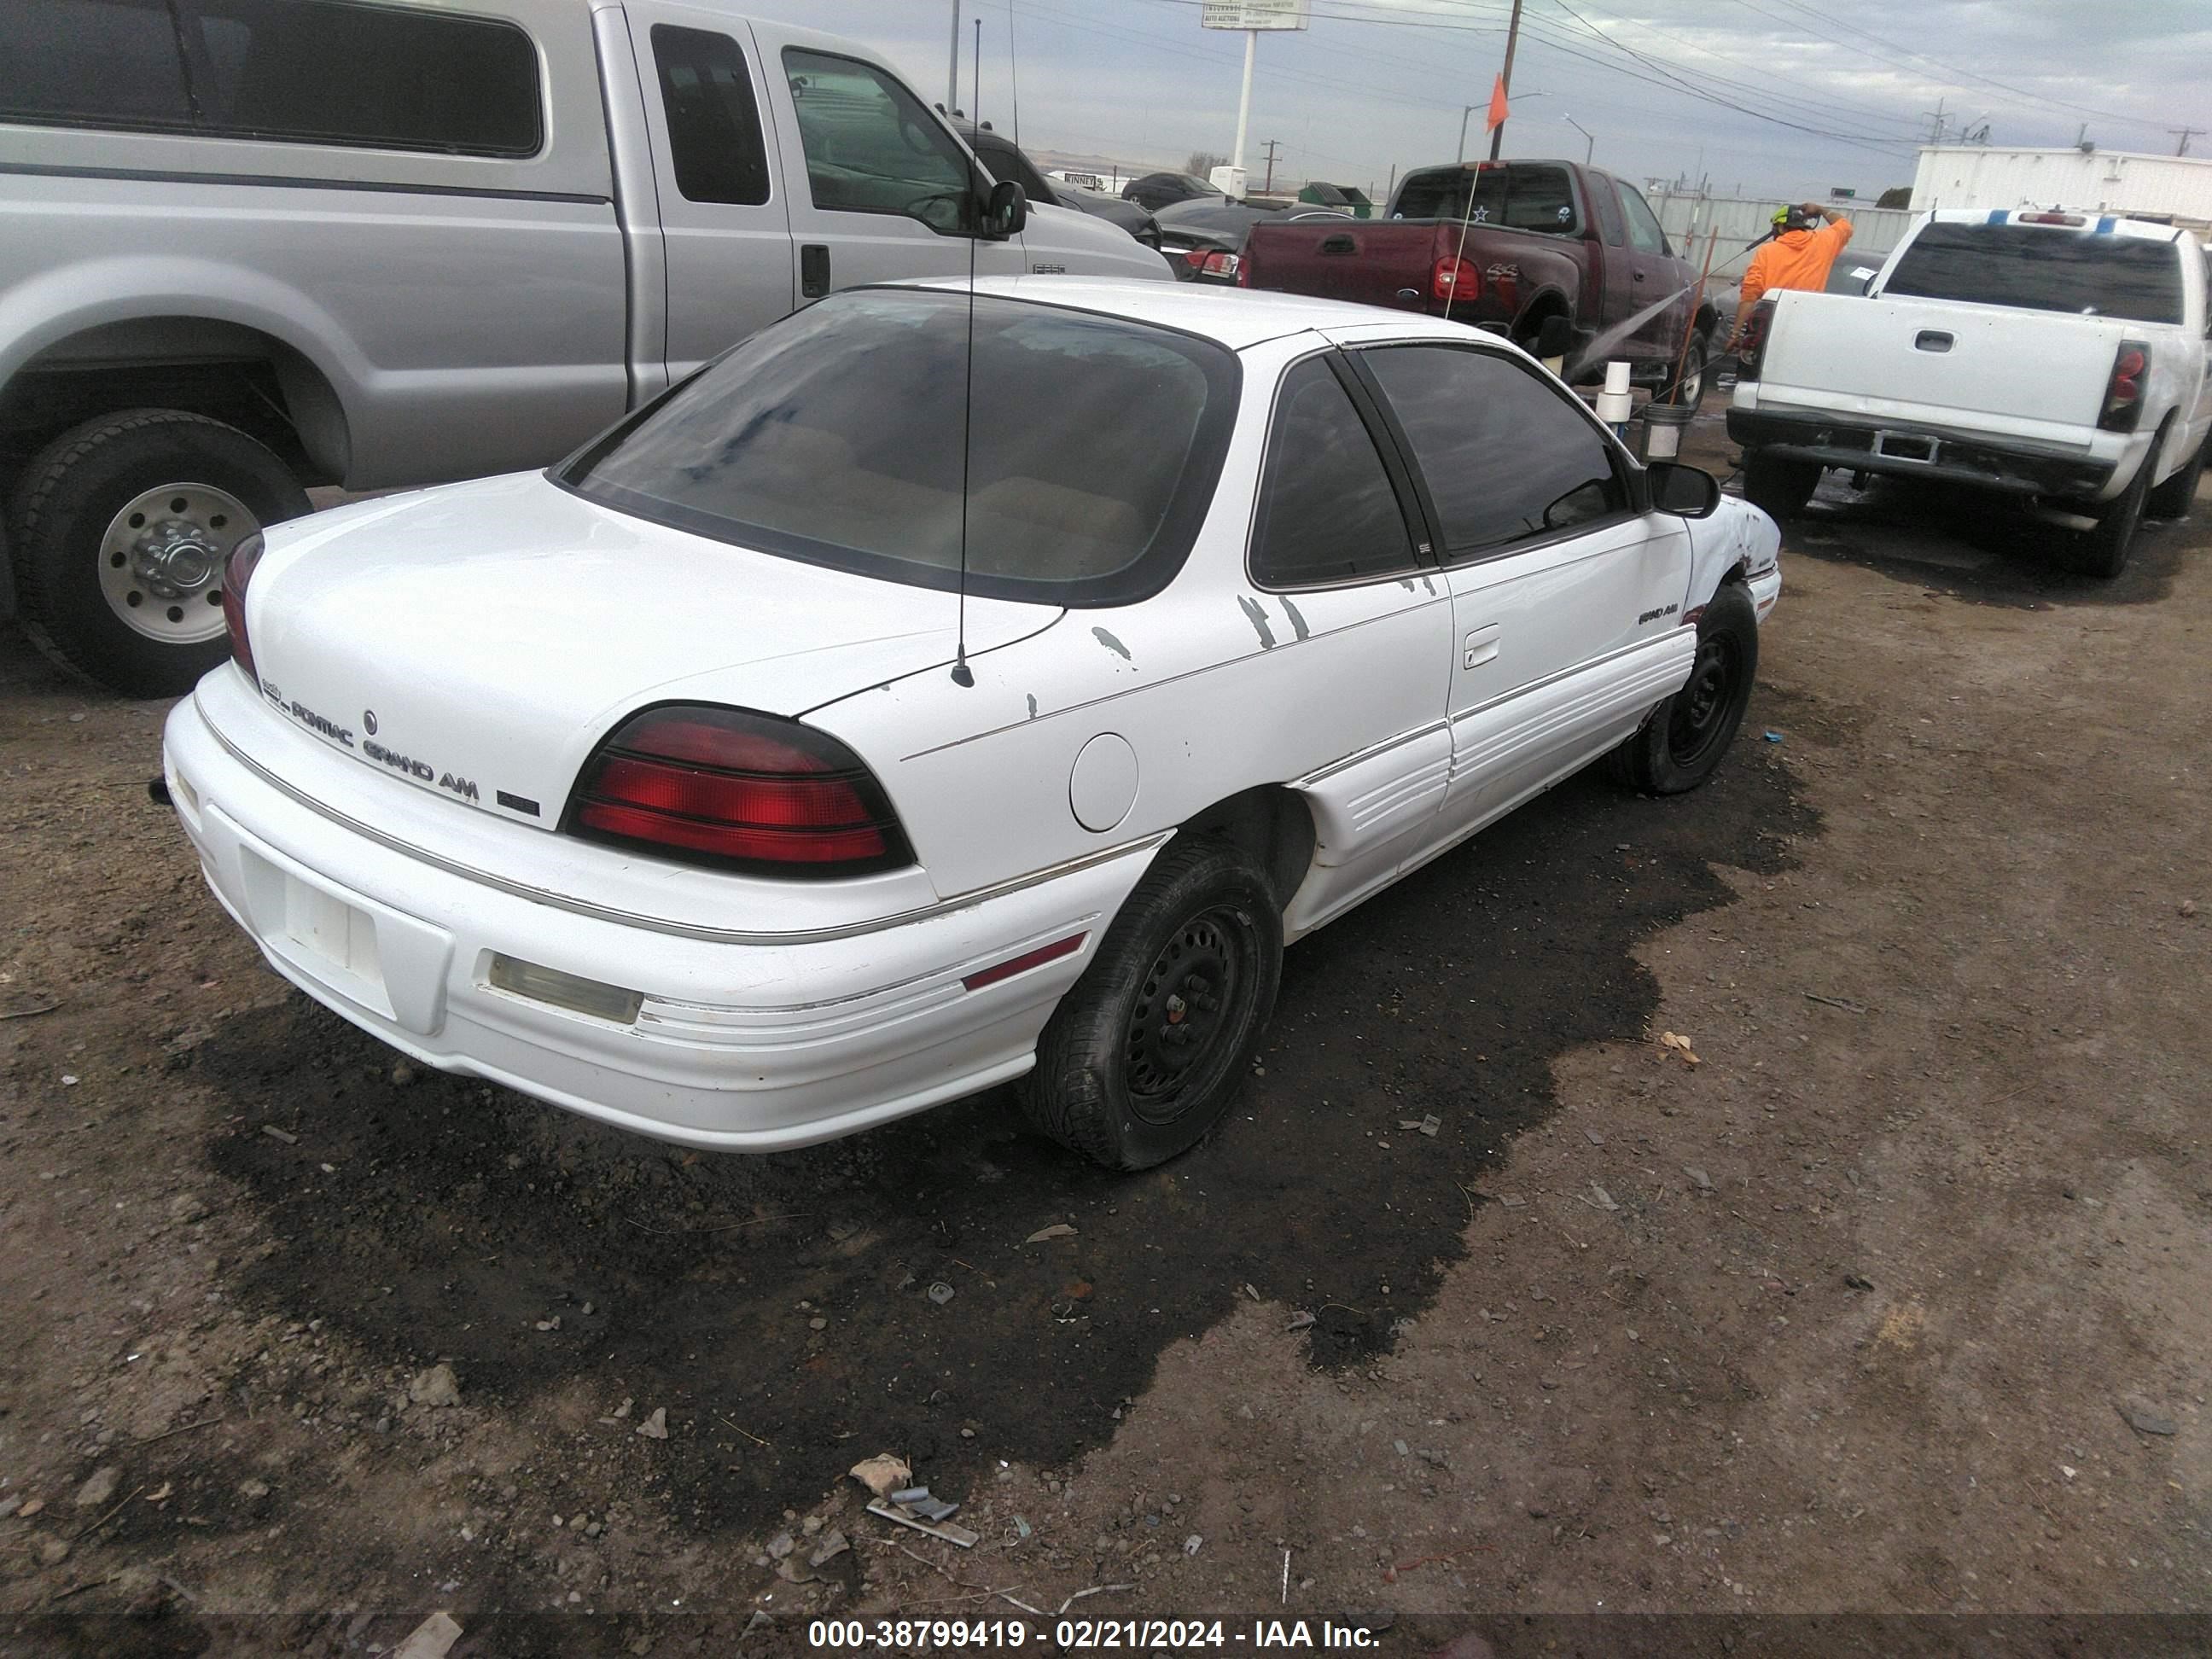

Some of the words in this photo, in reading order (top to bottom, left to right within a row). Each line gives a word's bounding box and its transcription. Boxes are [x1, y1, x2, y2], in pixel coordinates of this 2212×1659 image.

[292, 701, 354, 748] PONTIAC
[363, 739, 434, 782] GRAND
[439, 771, 480, 800] AM
